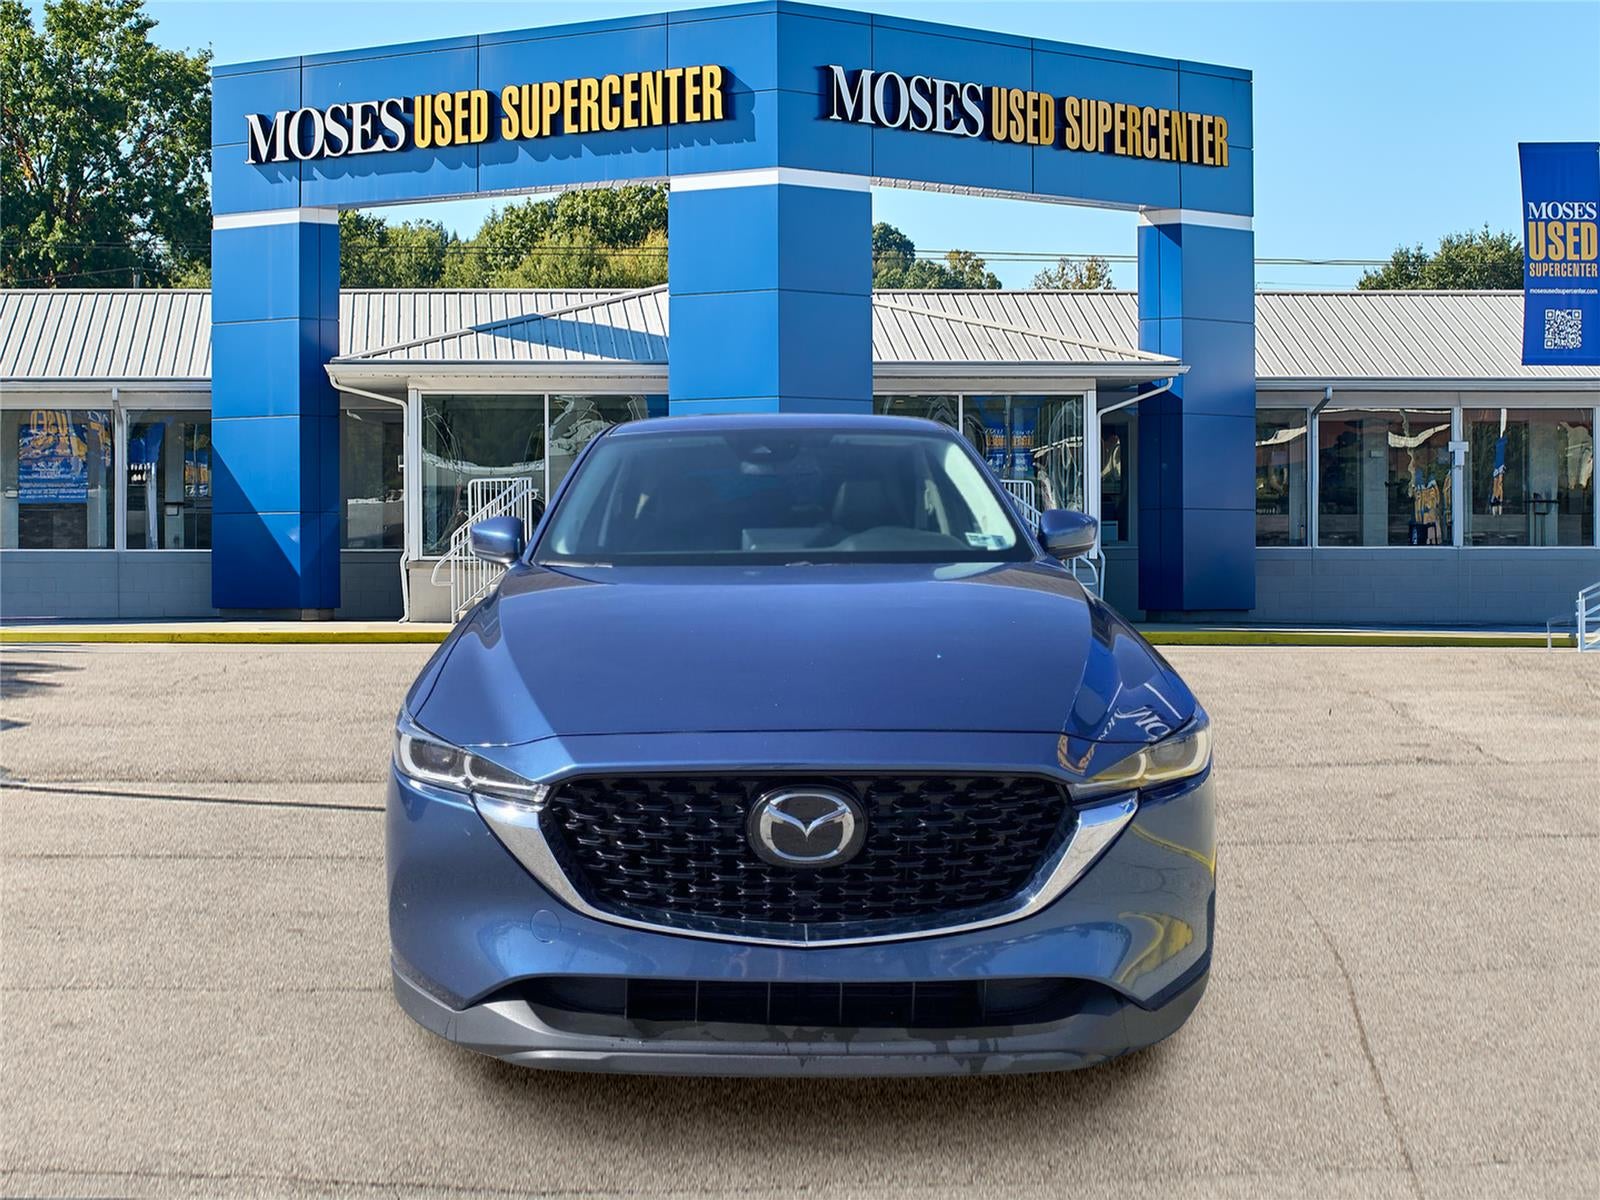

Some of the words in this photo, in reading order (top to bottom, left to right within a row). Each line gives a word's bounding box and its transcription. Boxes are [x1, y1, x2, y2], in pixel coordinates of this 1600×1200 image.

[245, 97, 406, 165] MOSES
[413, 88, 489, 150] USED
[500, 64, 725, 142] SUPERCENTER
[828, 64, 985, 138] MOSES
[991, 86, 1056, 146] USED
[1064, 96, 1230, 167] SUPERCENTER
[1527, 201, 1598, 220] MOSES
[1528, 221, 1599, 261] USED
[1529, 262, 1598, 278] SUPERCENTER
